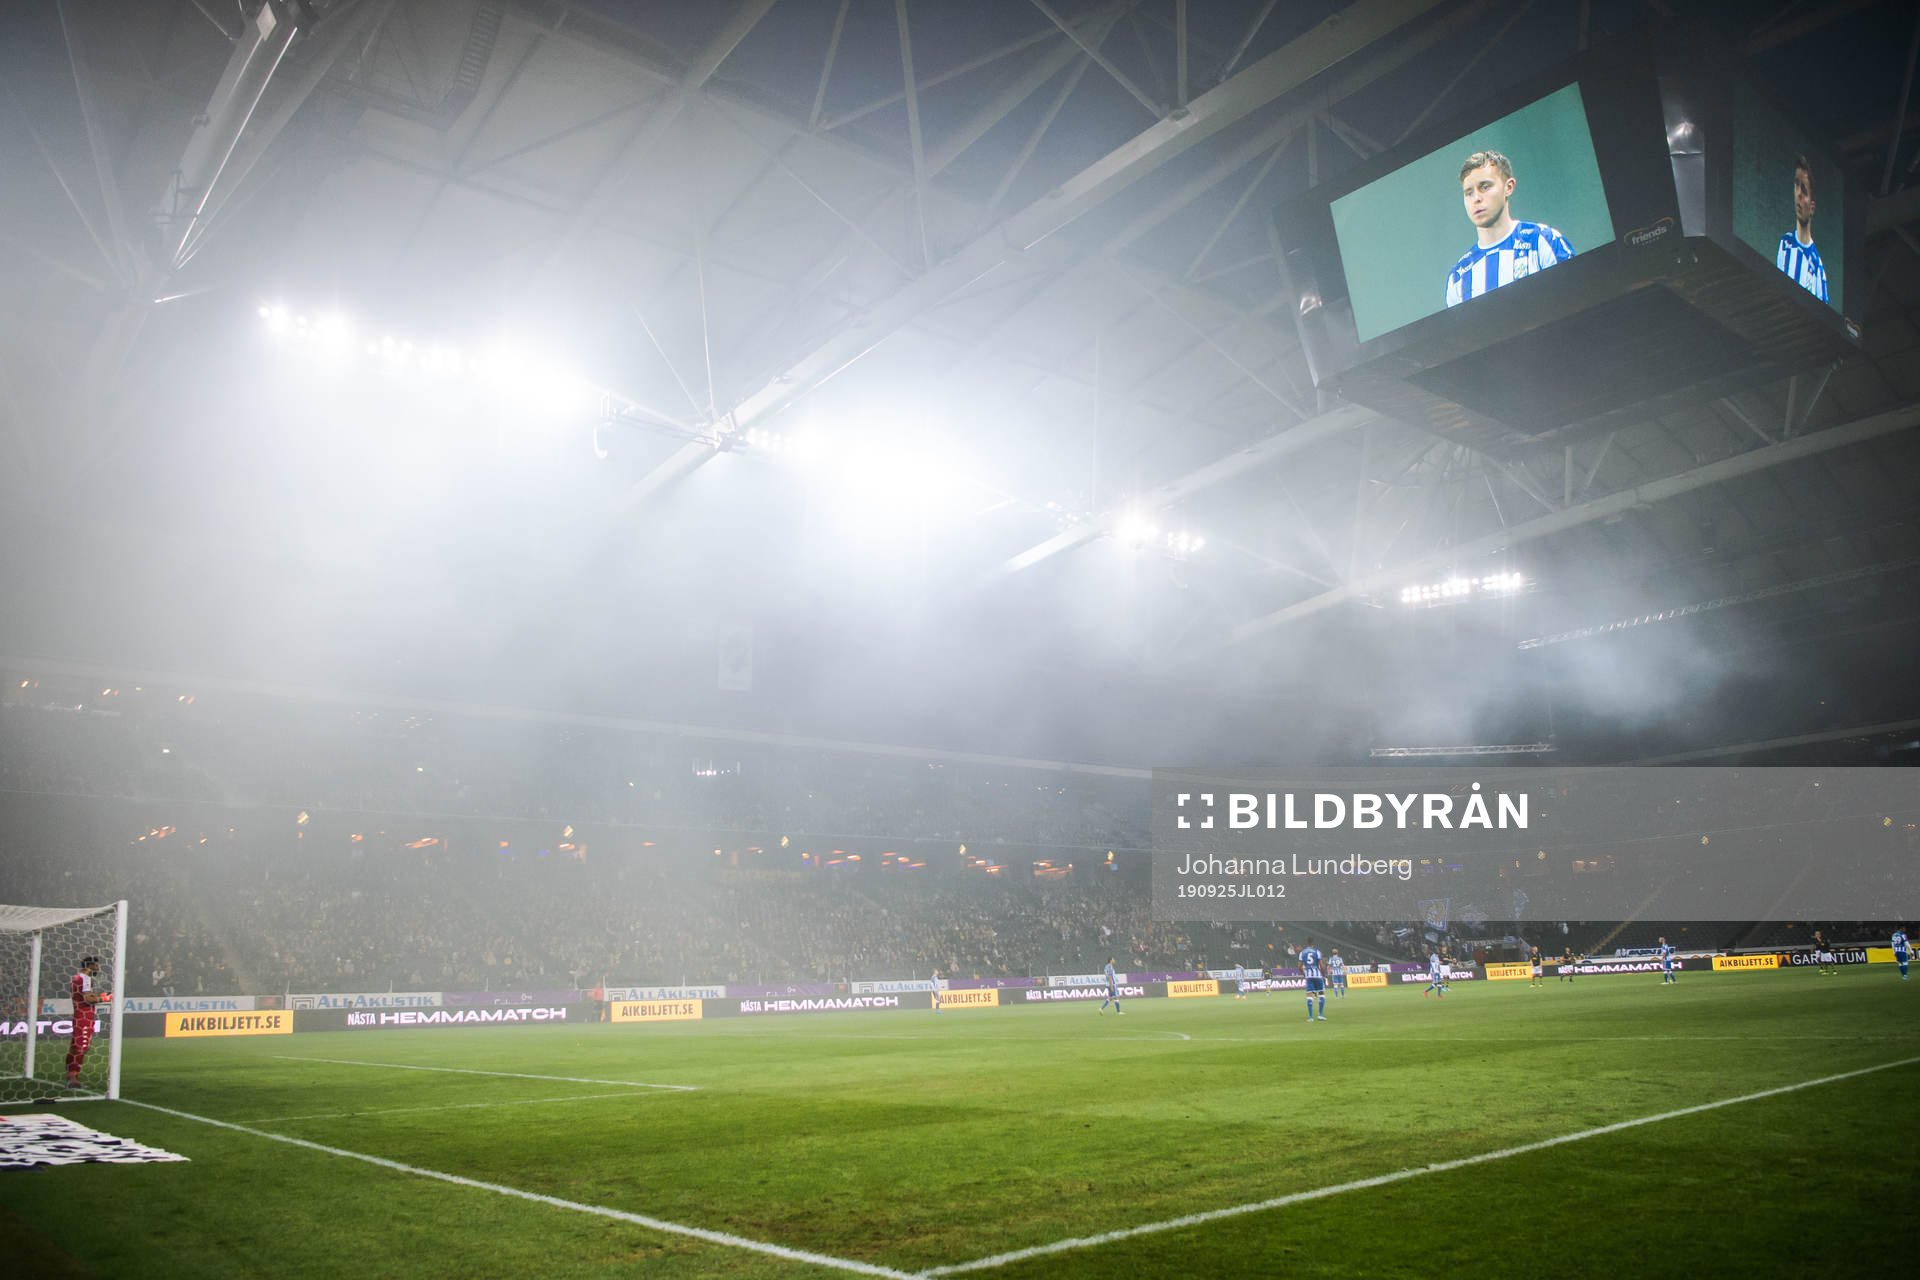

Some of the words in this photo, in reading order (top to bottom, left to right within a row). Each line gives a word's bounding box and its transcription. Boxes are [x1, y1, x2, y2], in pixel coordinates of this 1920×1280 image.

[1631, 226, 1667, 245] friends
[1307, 953, 1314, 964] 5
[1719, 957, 1775, 968] AIKBILJETT.SE
[1792, 951, 1867, 965] GARNTUM
[1574, 961, 1683, 974] HEMMAMATH
[1412, 971, 1473, 982] HEMATCH
[877, 981, 935, 992] ALLAKUST
[1043, 986, 1144, 999] HEMMAMTCH
[764, 996, 899, 1012] HEMMAMATCH
[939, 992, 992, 1005] AIKBILJETT.SE
[347, 1010, 376, 1026] NÄSTA
[380, 1007, 567, 1025] HEMMAMATCH
[621, 1003, 694, 1018] AIKBILJETT.SE
[180, 1015, 281, 1032] AIKBILJETT.SE
